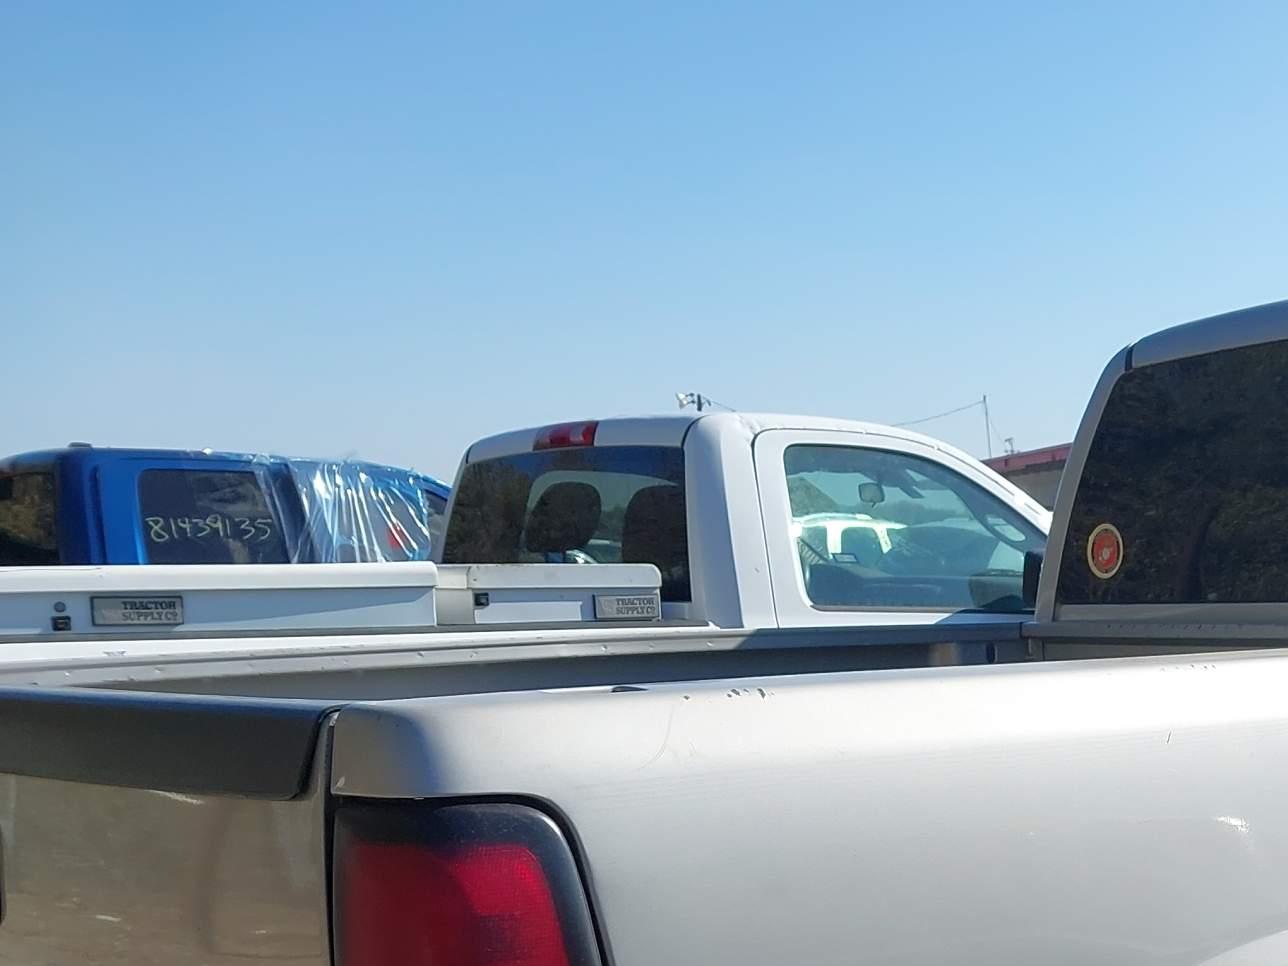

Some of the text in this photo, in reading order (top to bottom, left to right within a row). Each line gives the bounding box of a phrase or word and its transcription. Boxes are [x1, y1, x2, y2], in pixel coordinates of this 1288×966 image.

[145, 514, 273, 541] 81439135
[121, 600, 176, 611] TRACTOR
[121, 611, 161, 622] SUPPLY
